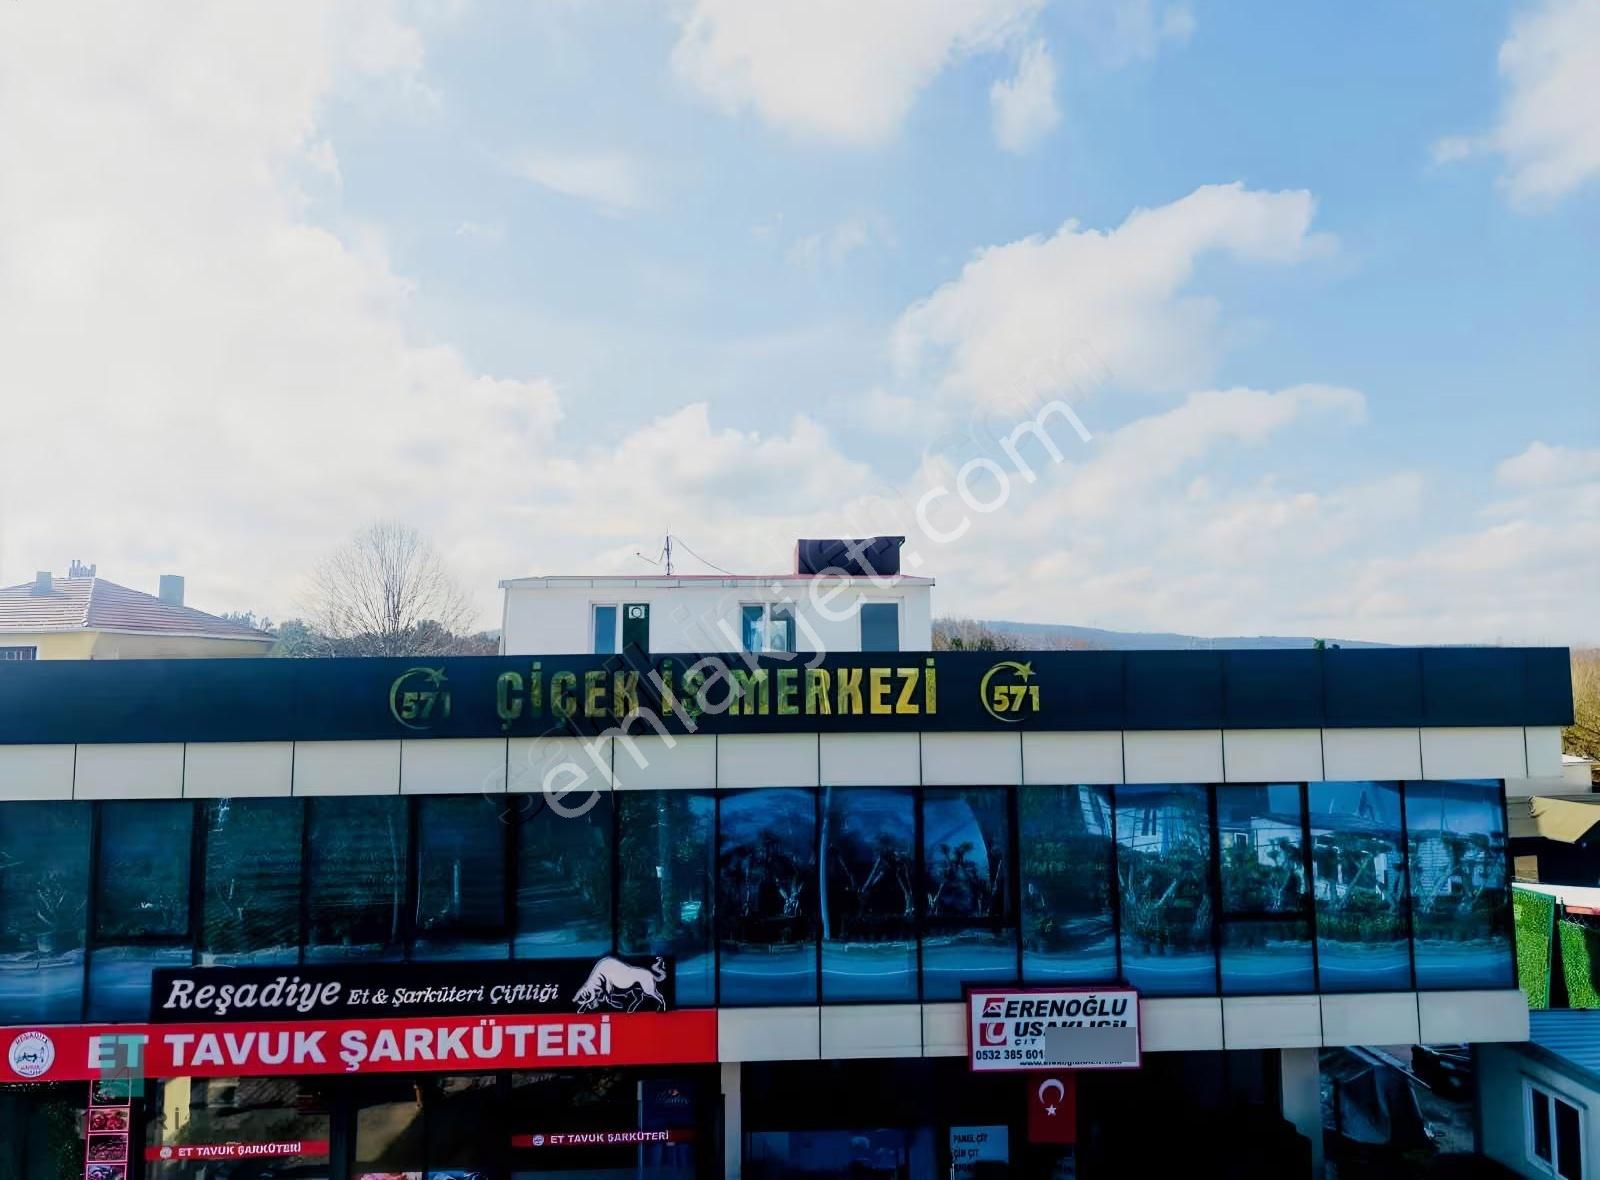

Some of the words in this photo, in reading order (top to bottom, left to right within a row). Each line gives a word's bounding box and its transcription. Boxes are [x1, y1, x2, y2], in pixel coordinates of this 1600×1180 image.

[728, 658, 937, 716] MERKEZİ
[993, 685, 1040, 712] 571
[162, 976, 342, 1016] Reşadiye
[347, 988, 370, 1005] Et
[372, 988, 388, 1005] &
[391, 985, 485, 1008] Şarküteri
[490, 983, 560, 1005] Çiftliği
[1005, 995, 1128, 1018] ERENOĞLU
[87, 1034, 150, 1069] ET
[163, 1029, 327, 1067] TAVUK
[339, 1015, 612, 1072] ŞARKÜTERİ
[975, 1050, 1001, 1061] 0532
[178, 1147, 193, 1157] ET
[196, 1145, 235, 1156] TAVUK
[551, 1135, 565, 1144] ET
[567, 1133, 604, 1143] TAVUK
